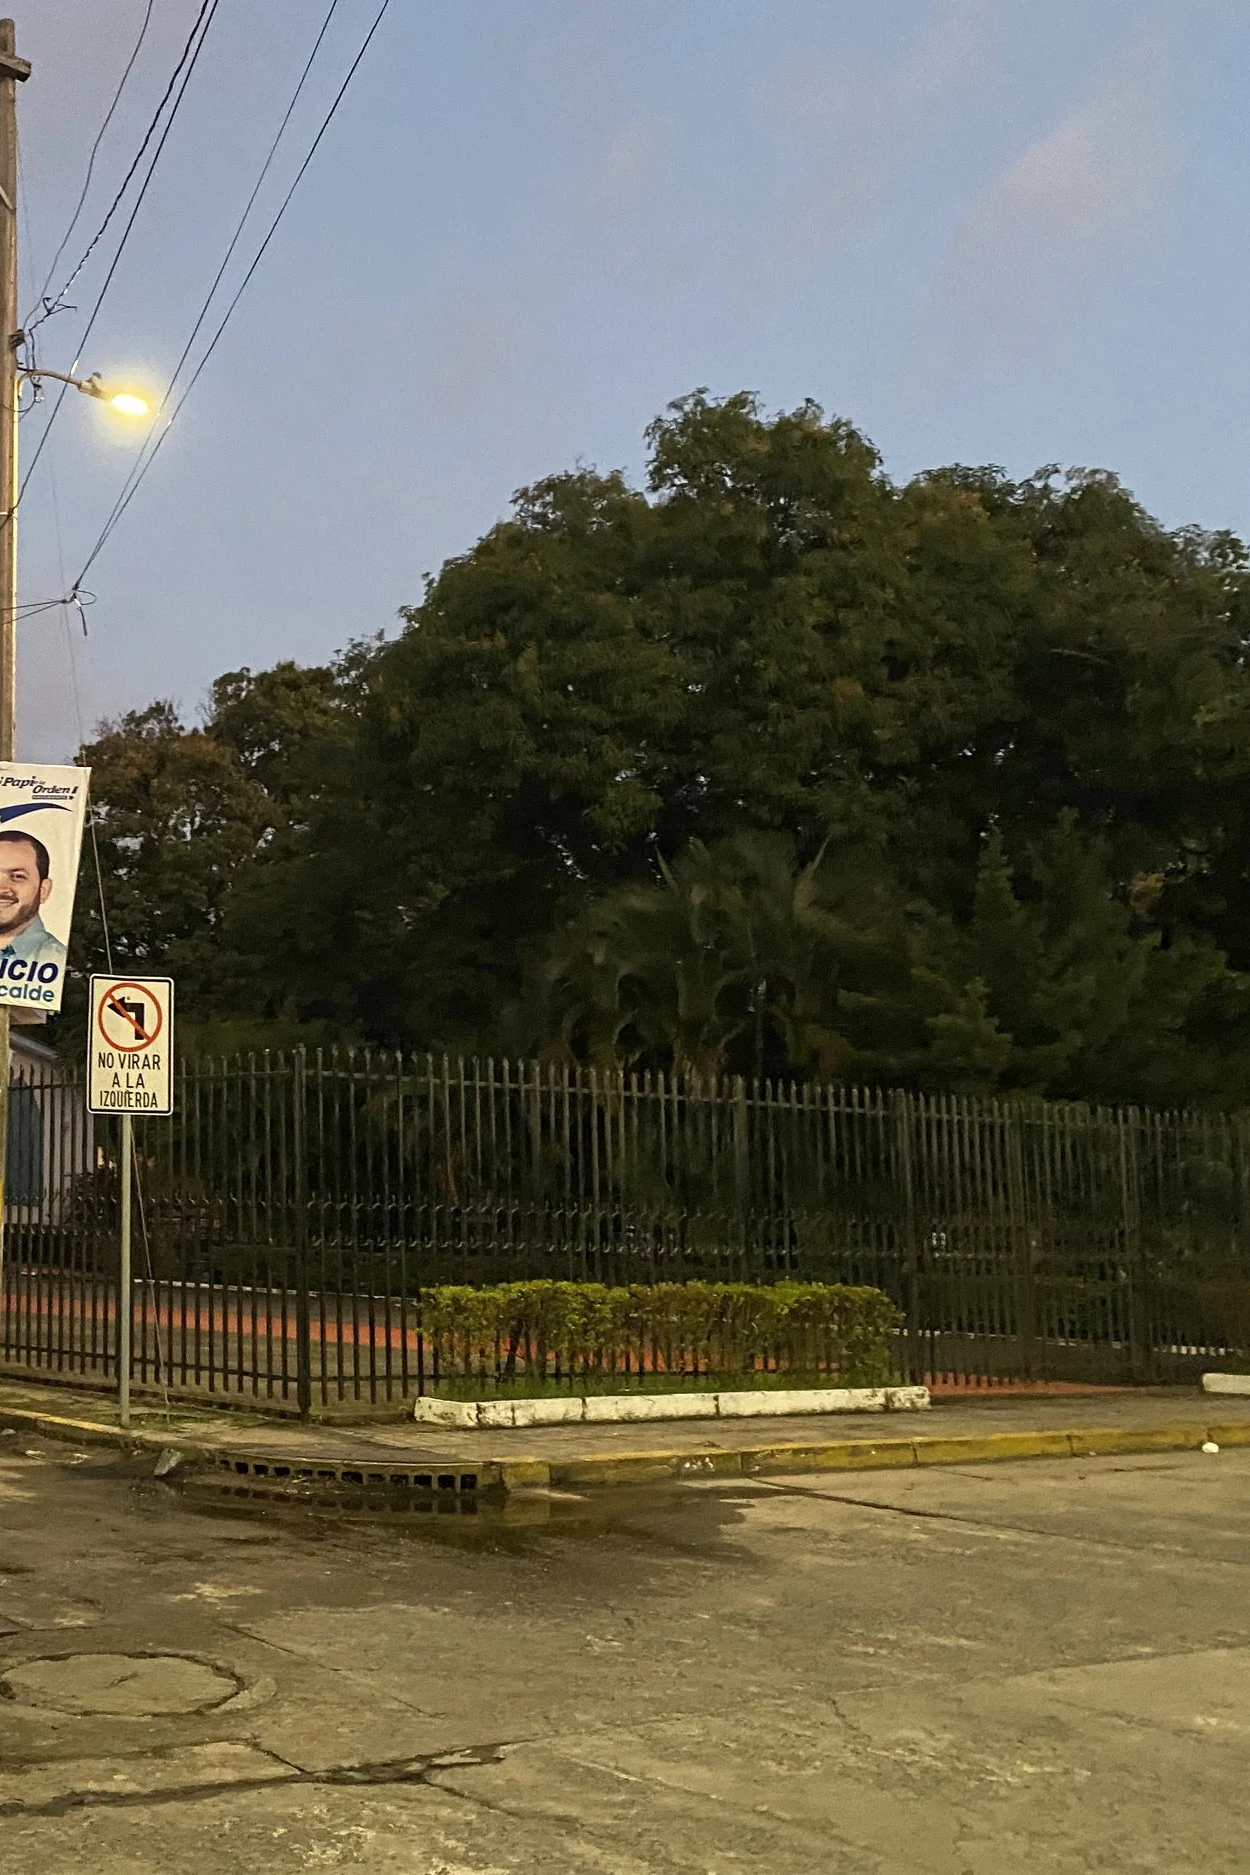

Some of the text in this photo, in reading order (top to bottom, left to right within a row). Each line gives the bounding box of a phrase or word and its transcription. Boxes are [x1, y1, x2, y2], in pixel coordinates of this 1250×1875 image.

[98, 1052, 161, 1070] NO VIRAR
[112, 1072, 145, 1088] A LA
[99, 1090, 158, 1108] IZQUIERDA
